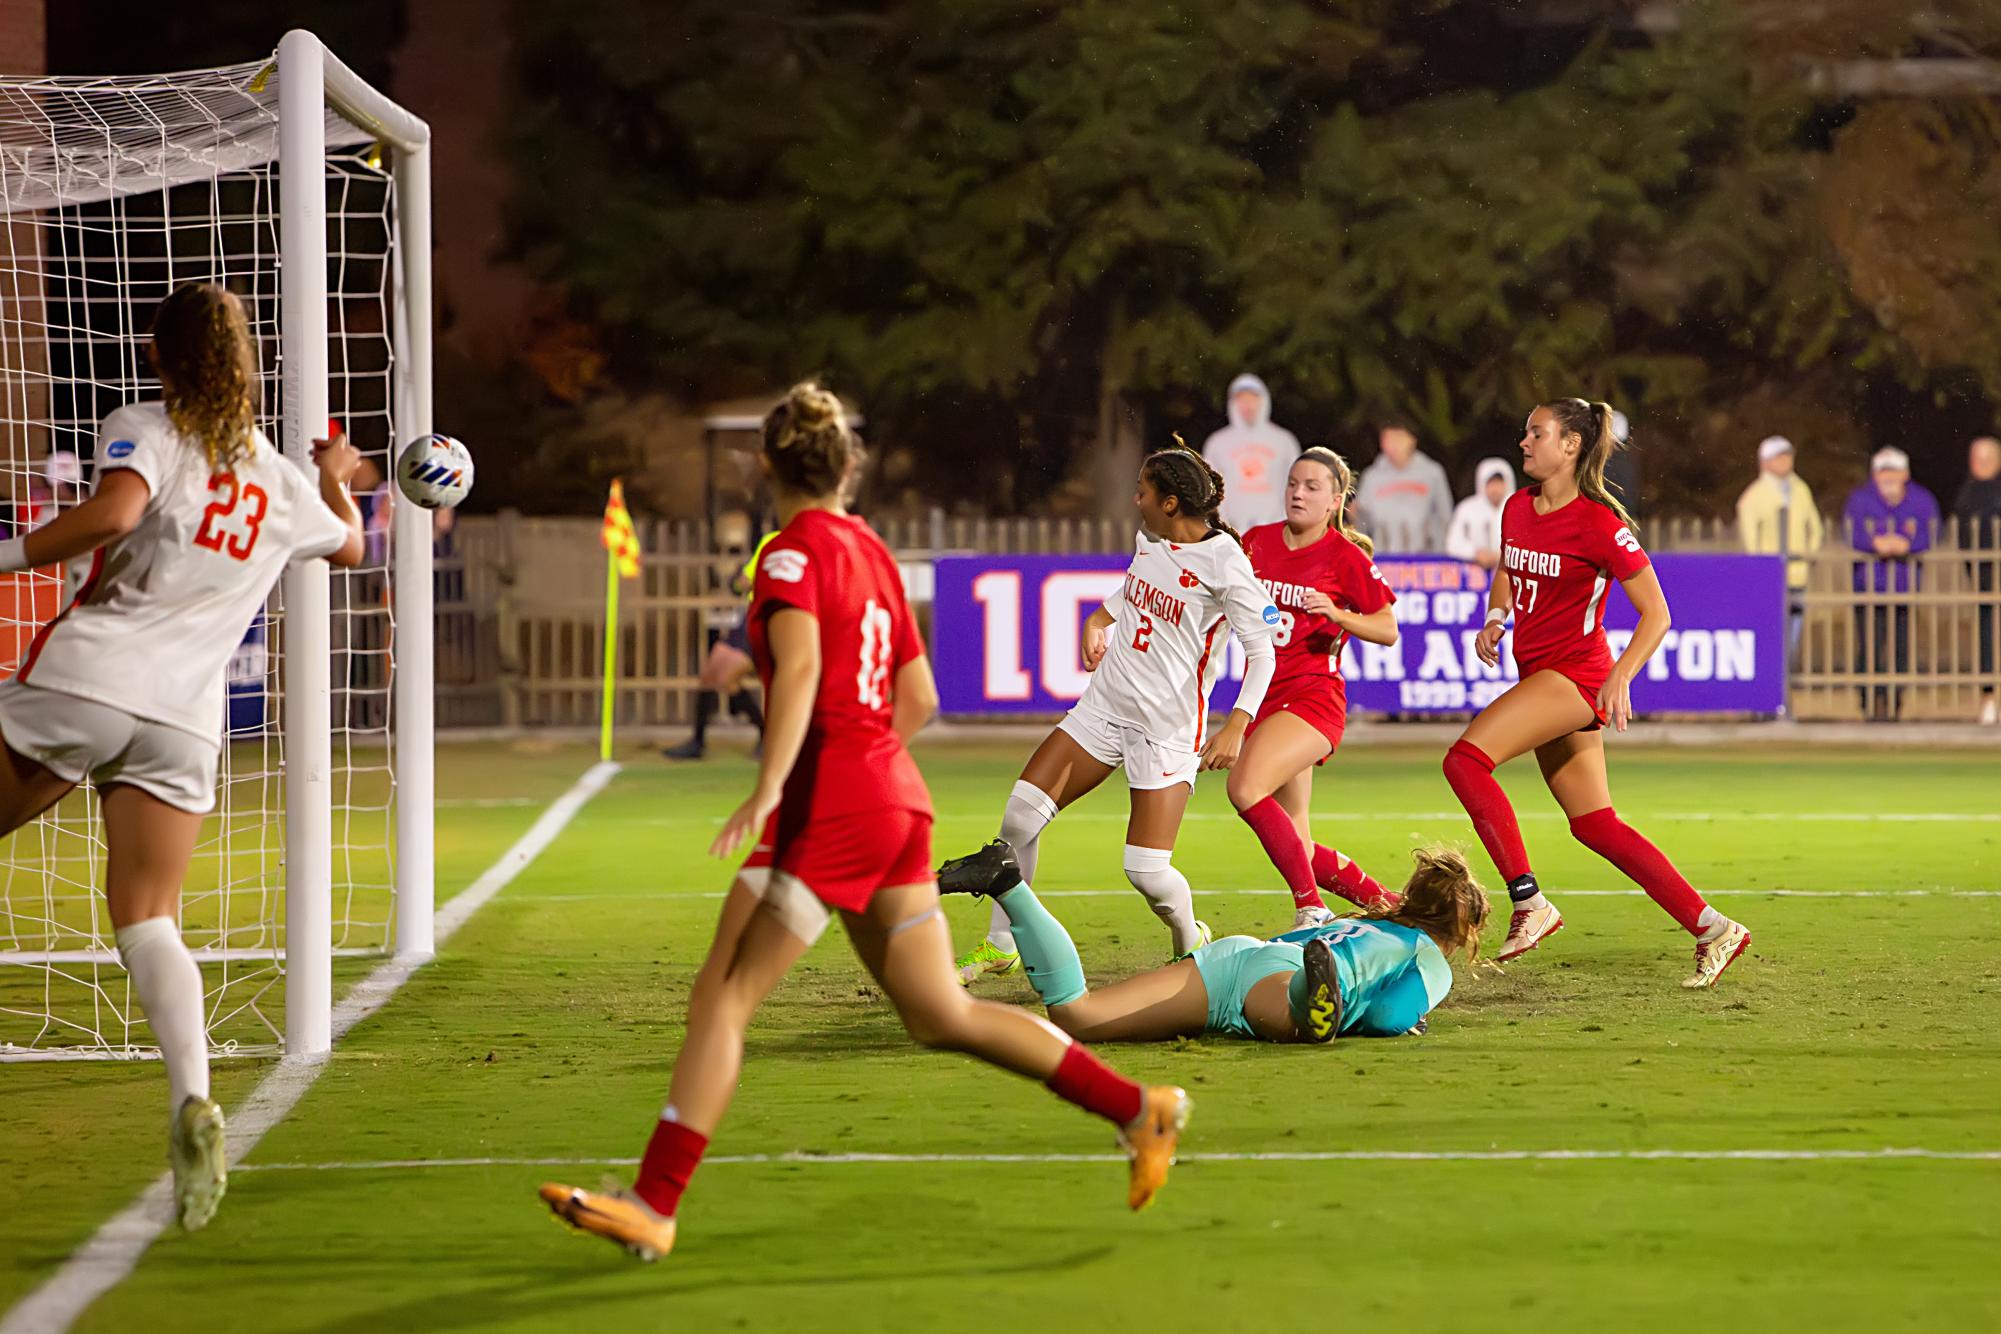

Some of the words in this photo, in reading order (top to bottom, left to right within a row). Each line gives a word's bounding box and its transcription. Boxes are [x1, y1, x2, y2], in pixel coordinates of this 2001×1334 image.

[194, 471, 268, 562] 23
[1124, 573, 1186, 628] CLEMSON
[1432, 591, 1479, 625] OF
[1512, 576, 1538, 613] 27
[1132, 614, 1153, 653] 2
